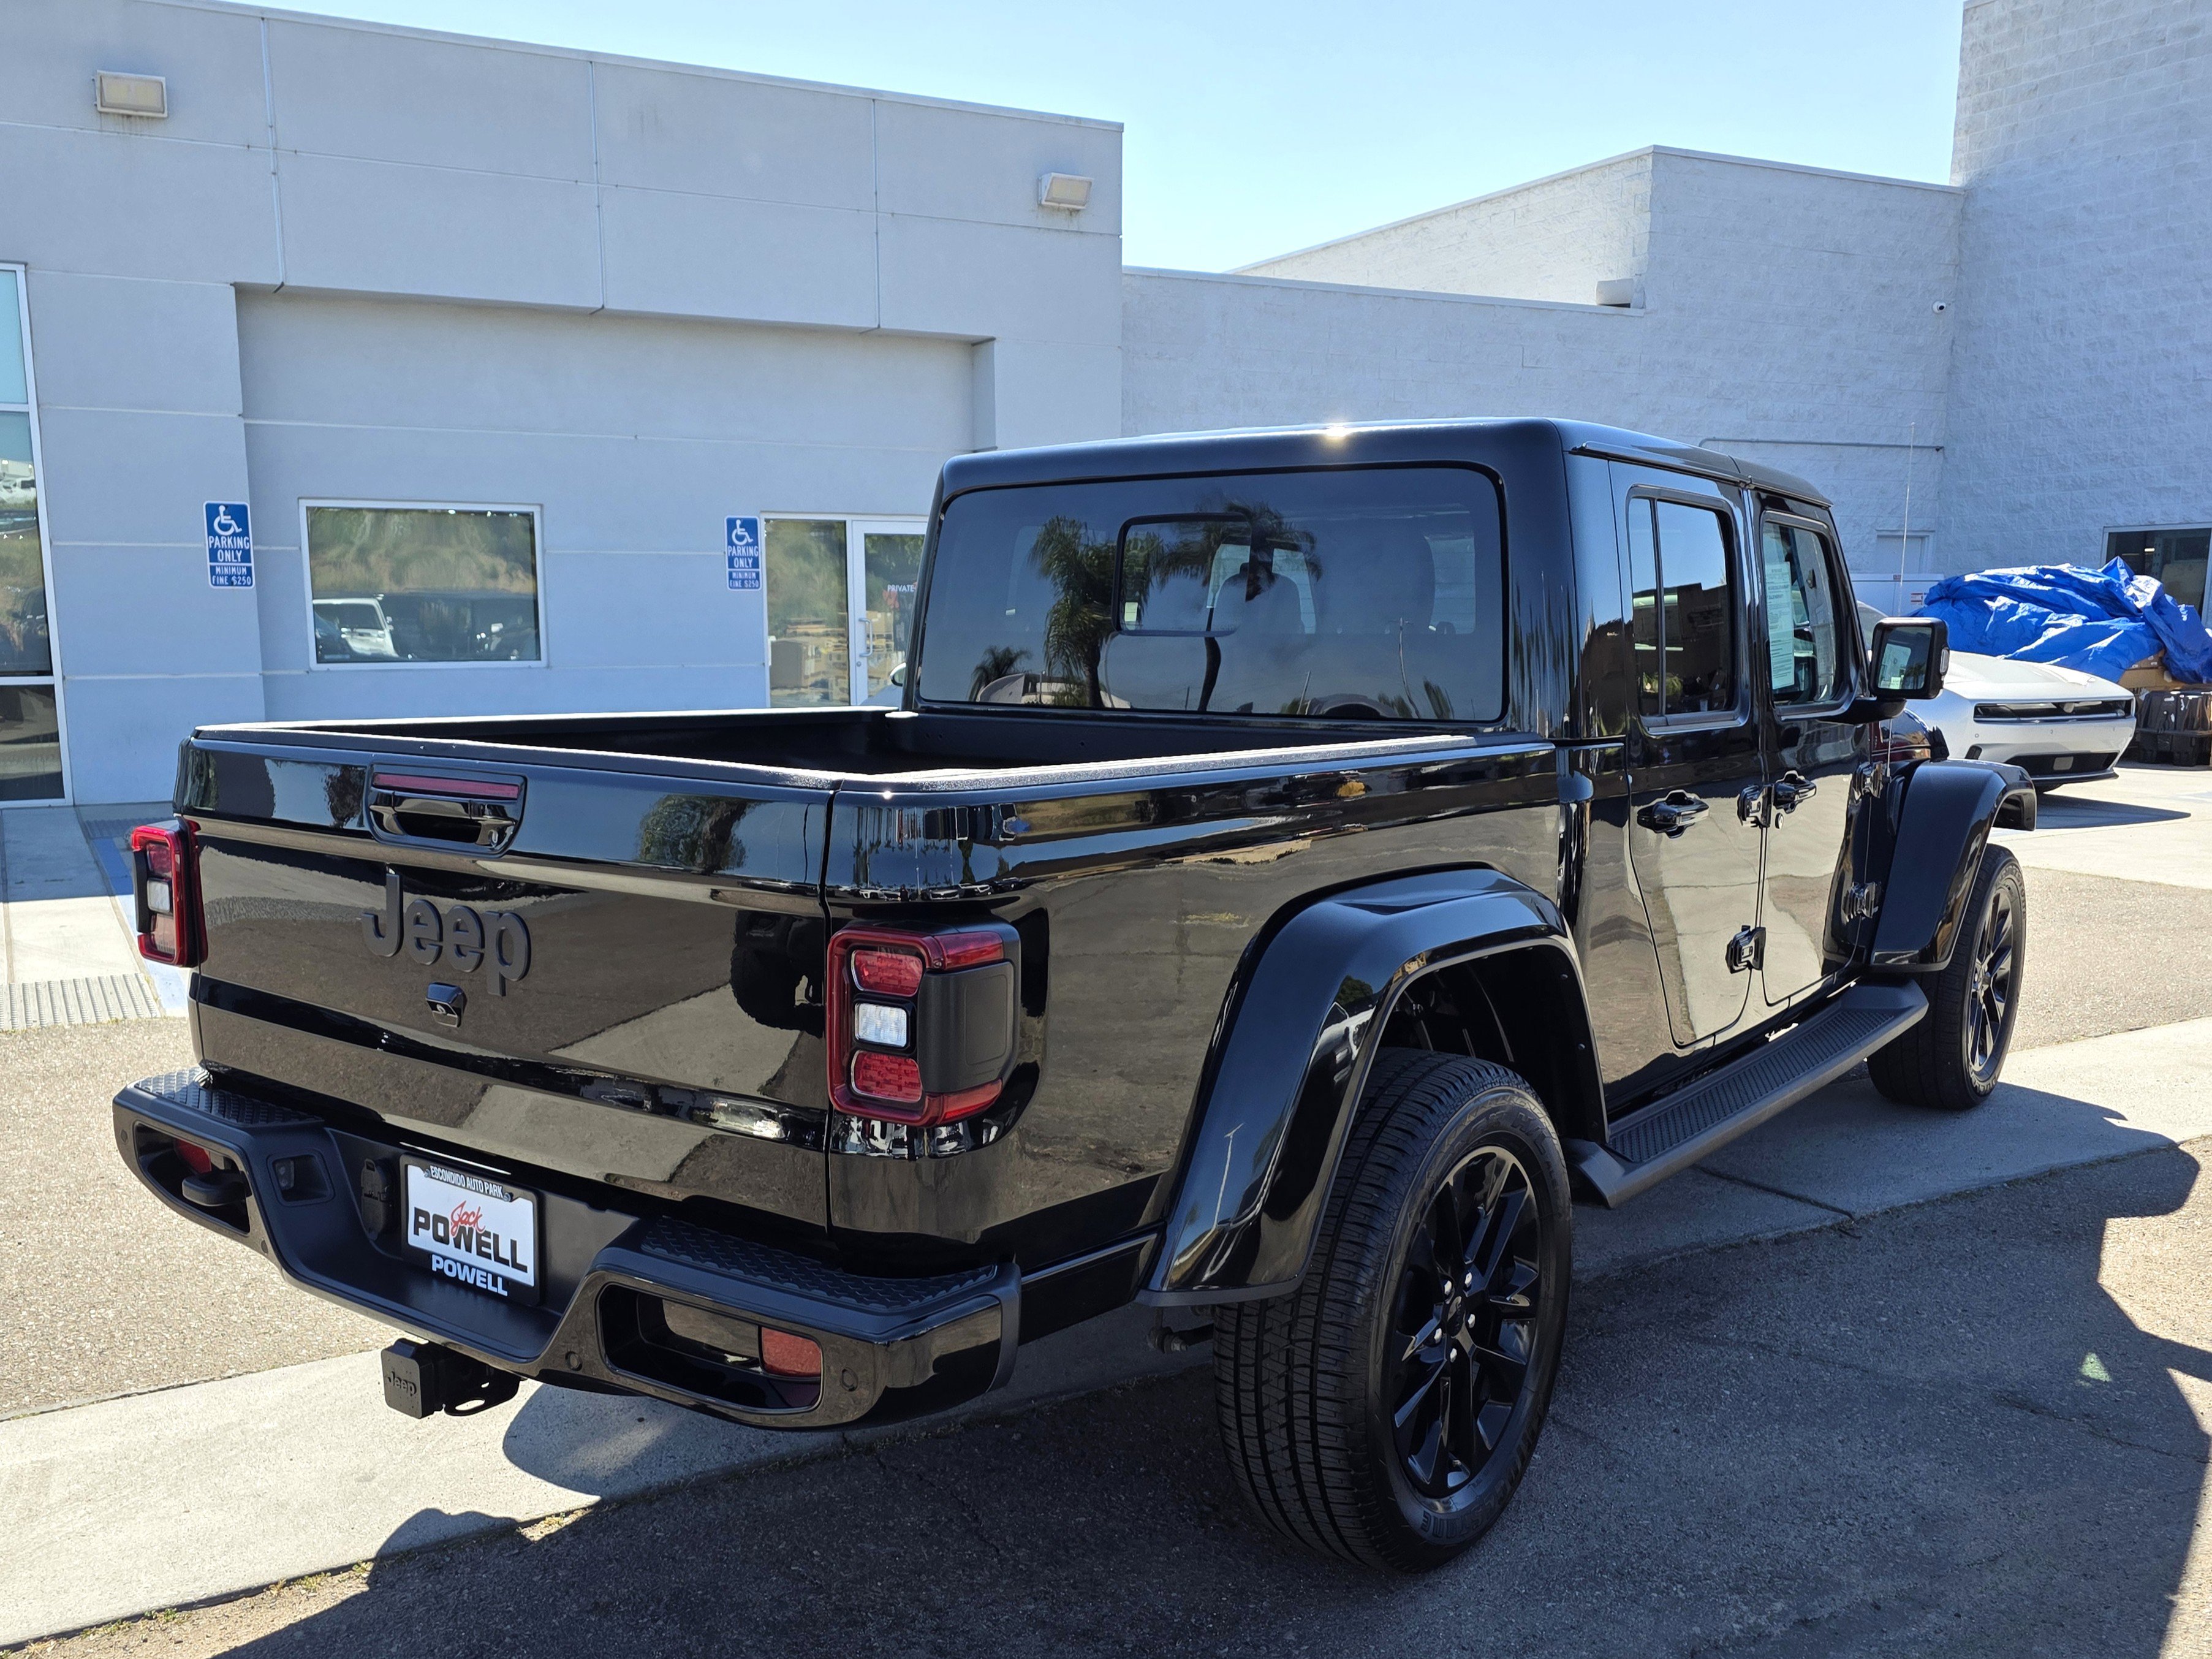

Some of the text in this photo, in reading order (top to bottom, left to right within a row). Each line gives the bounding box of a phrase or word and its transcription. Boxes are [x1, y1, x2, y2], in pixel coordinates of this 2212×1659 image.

[208, 535, 249, 549] PARKING
[217, 549, 243, 563] ONLY
[727, 545, 759, 557] PARKING
[733, 557, 753, 569] ONLY
[215, 566, 247, 575] MINIMUM
[212, 575, 251, 585] FINE $250
[729, 579, 759, 588] FINE $250
[887, 584, 915, 593] PRIVATE
[361, 873, 532, 997] Jeep
[430, 1165, 504, 1198] ESCONDIDO AUTO PARK
[450, 1200, 486, 1237] Jack
[413, 1207, 528, 1274] POWELL
[431, 1254, 508, 1297] POWELL
[387, 1370, 417, 1398] Jeep
